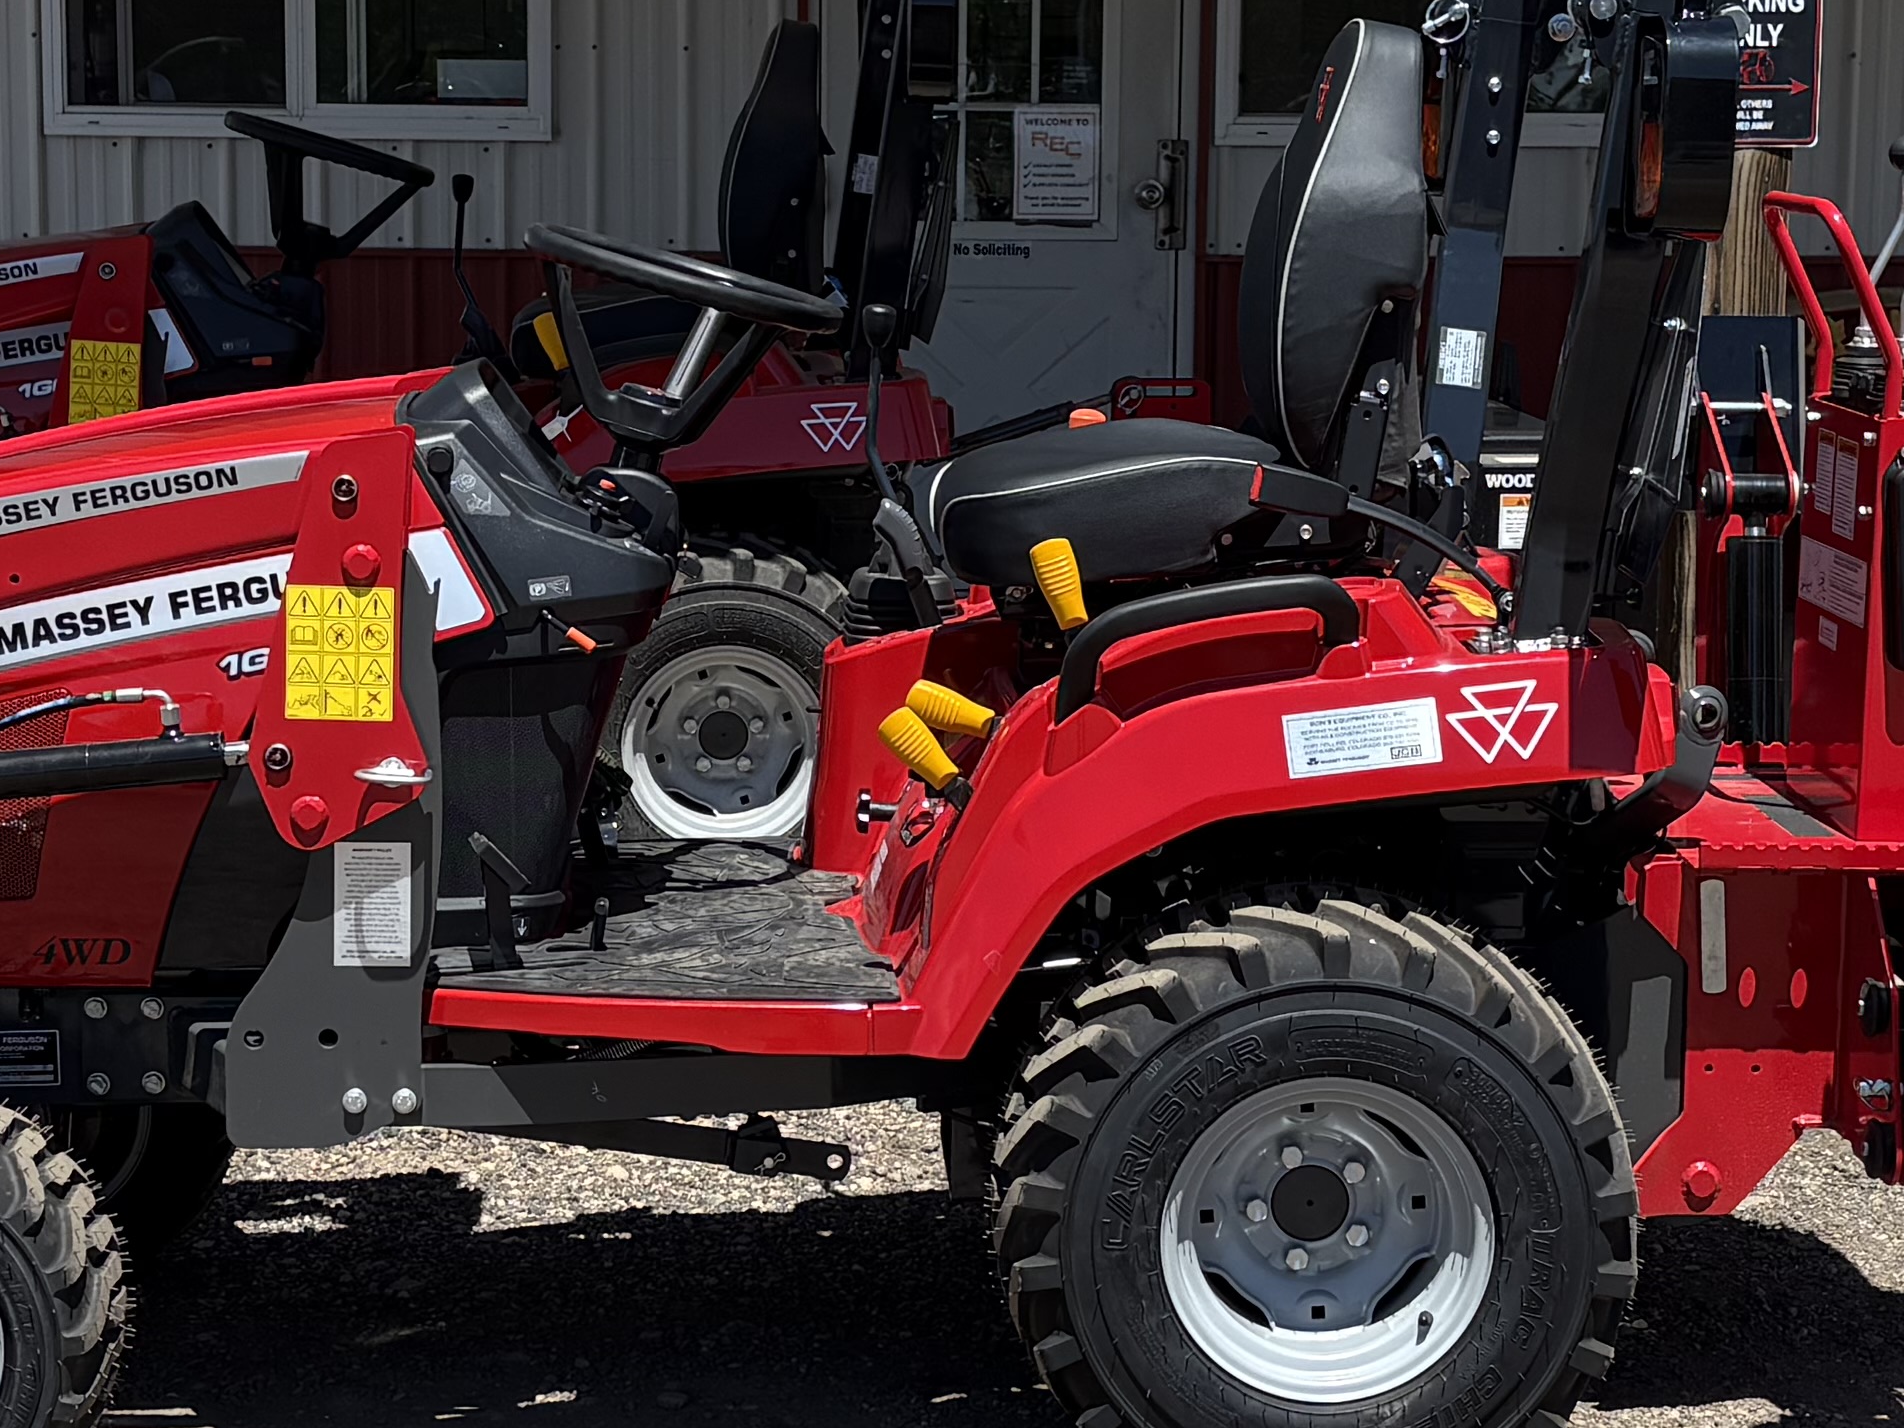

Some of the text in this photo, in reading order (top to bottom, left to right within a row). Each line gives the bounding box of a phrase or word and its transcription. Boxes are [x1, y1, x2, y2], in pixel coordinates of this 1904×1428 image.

[1739, 23, 1784, 47] NLY
[1025, 118, 1090, 126] WELCOME TO
[1031, 132, 1083, 157] REC
[953, 243, 1030, 259] No Soliciting
[73, 466, 240, 513] FERGUSON
[168, 573, 286, 621] FERGU
[33, 935, 132, 966] 4WD
[1102, 1034, 1268, 1250] CARLSTAR
